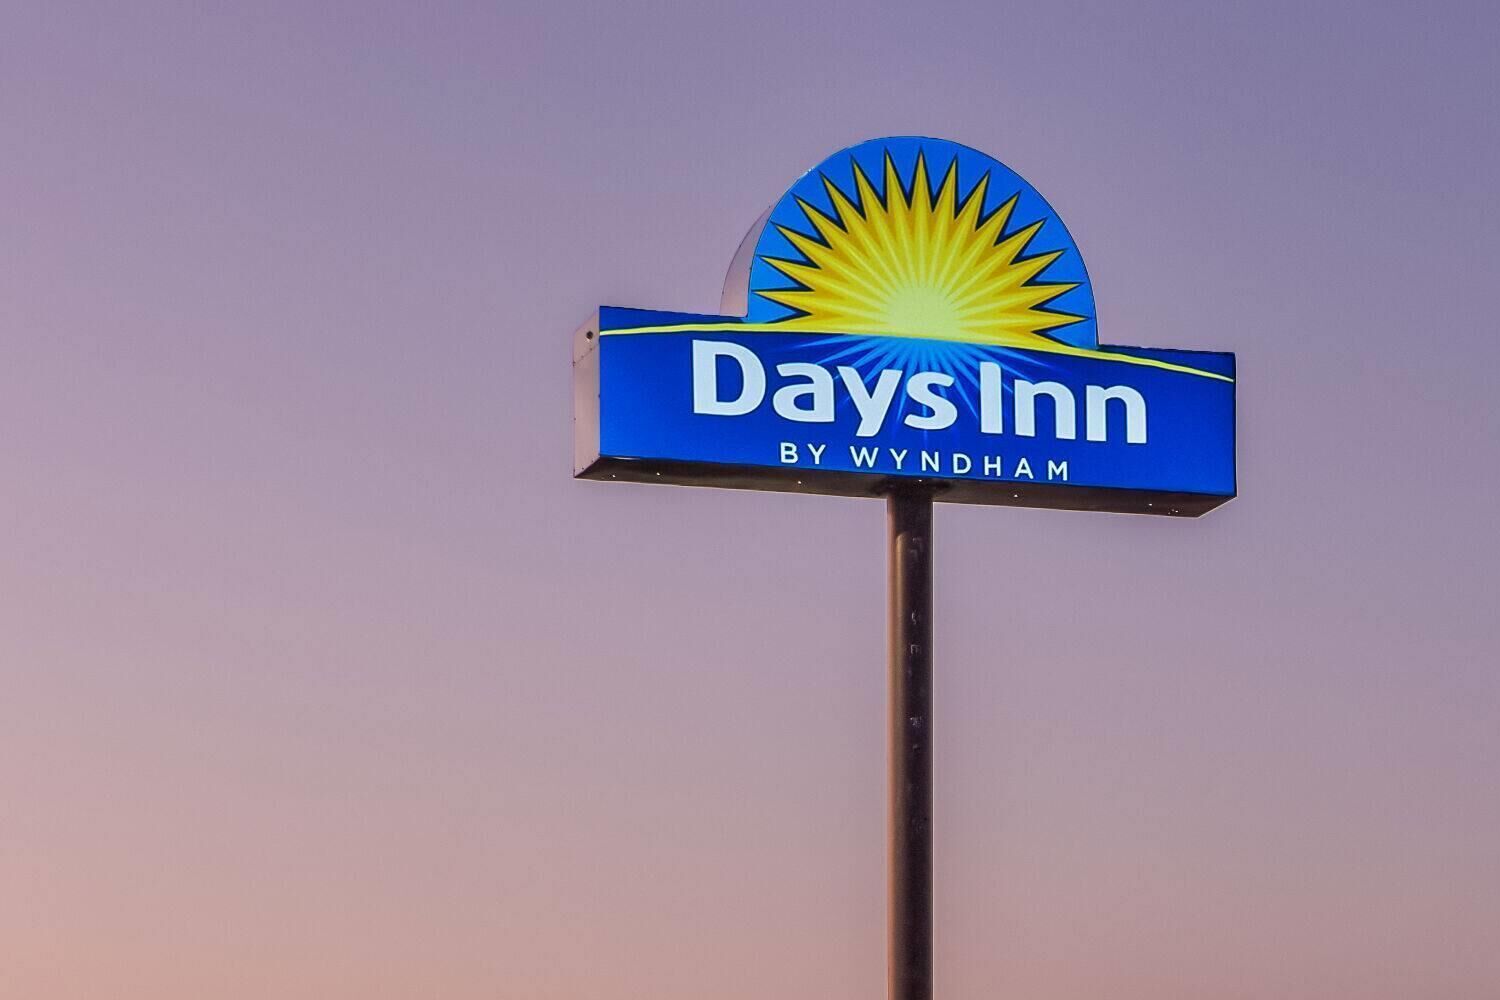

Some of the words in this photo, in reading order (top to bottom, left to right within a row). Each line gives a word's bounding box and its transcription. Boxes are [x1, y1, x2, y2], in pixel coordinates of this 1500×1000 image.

[692, 339, 958, 437] Days
[980, 361, 1147, 444] Inn
[780, 442, 826, 465] BY
[849, 445, 1069, 481] WYNDHAM
